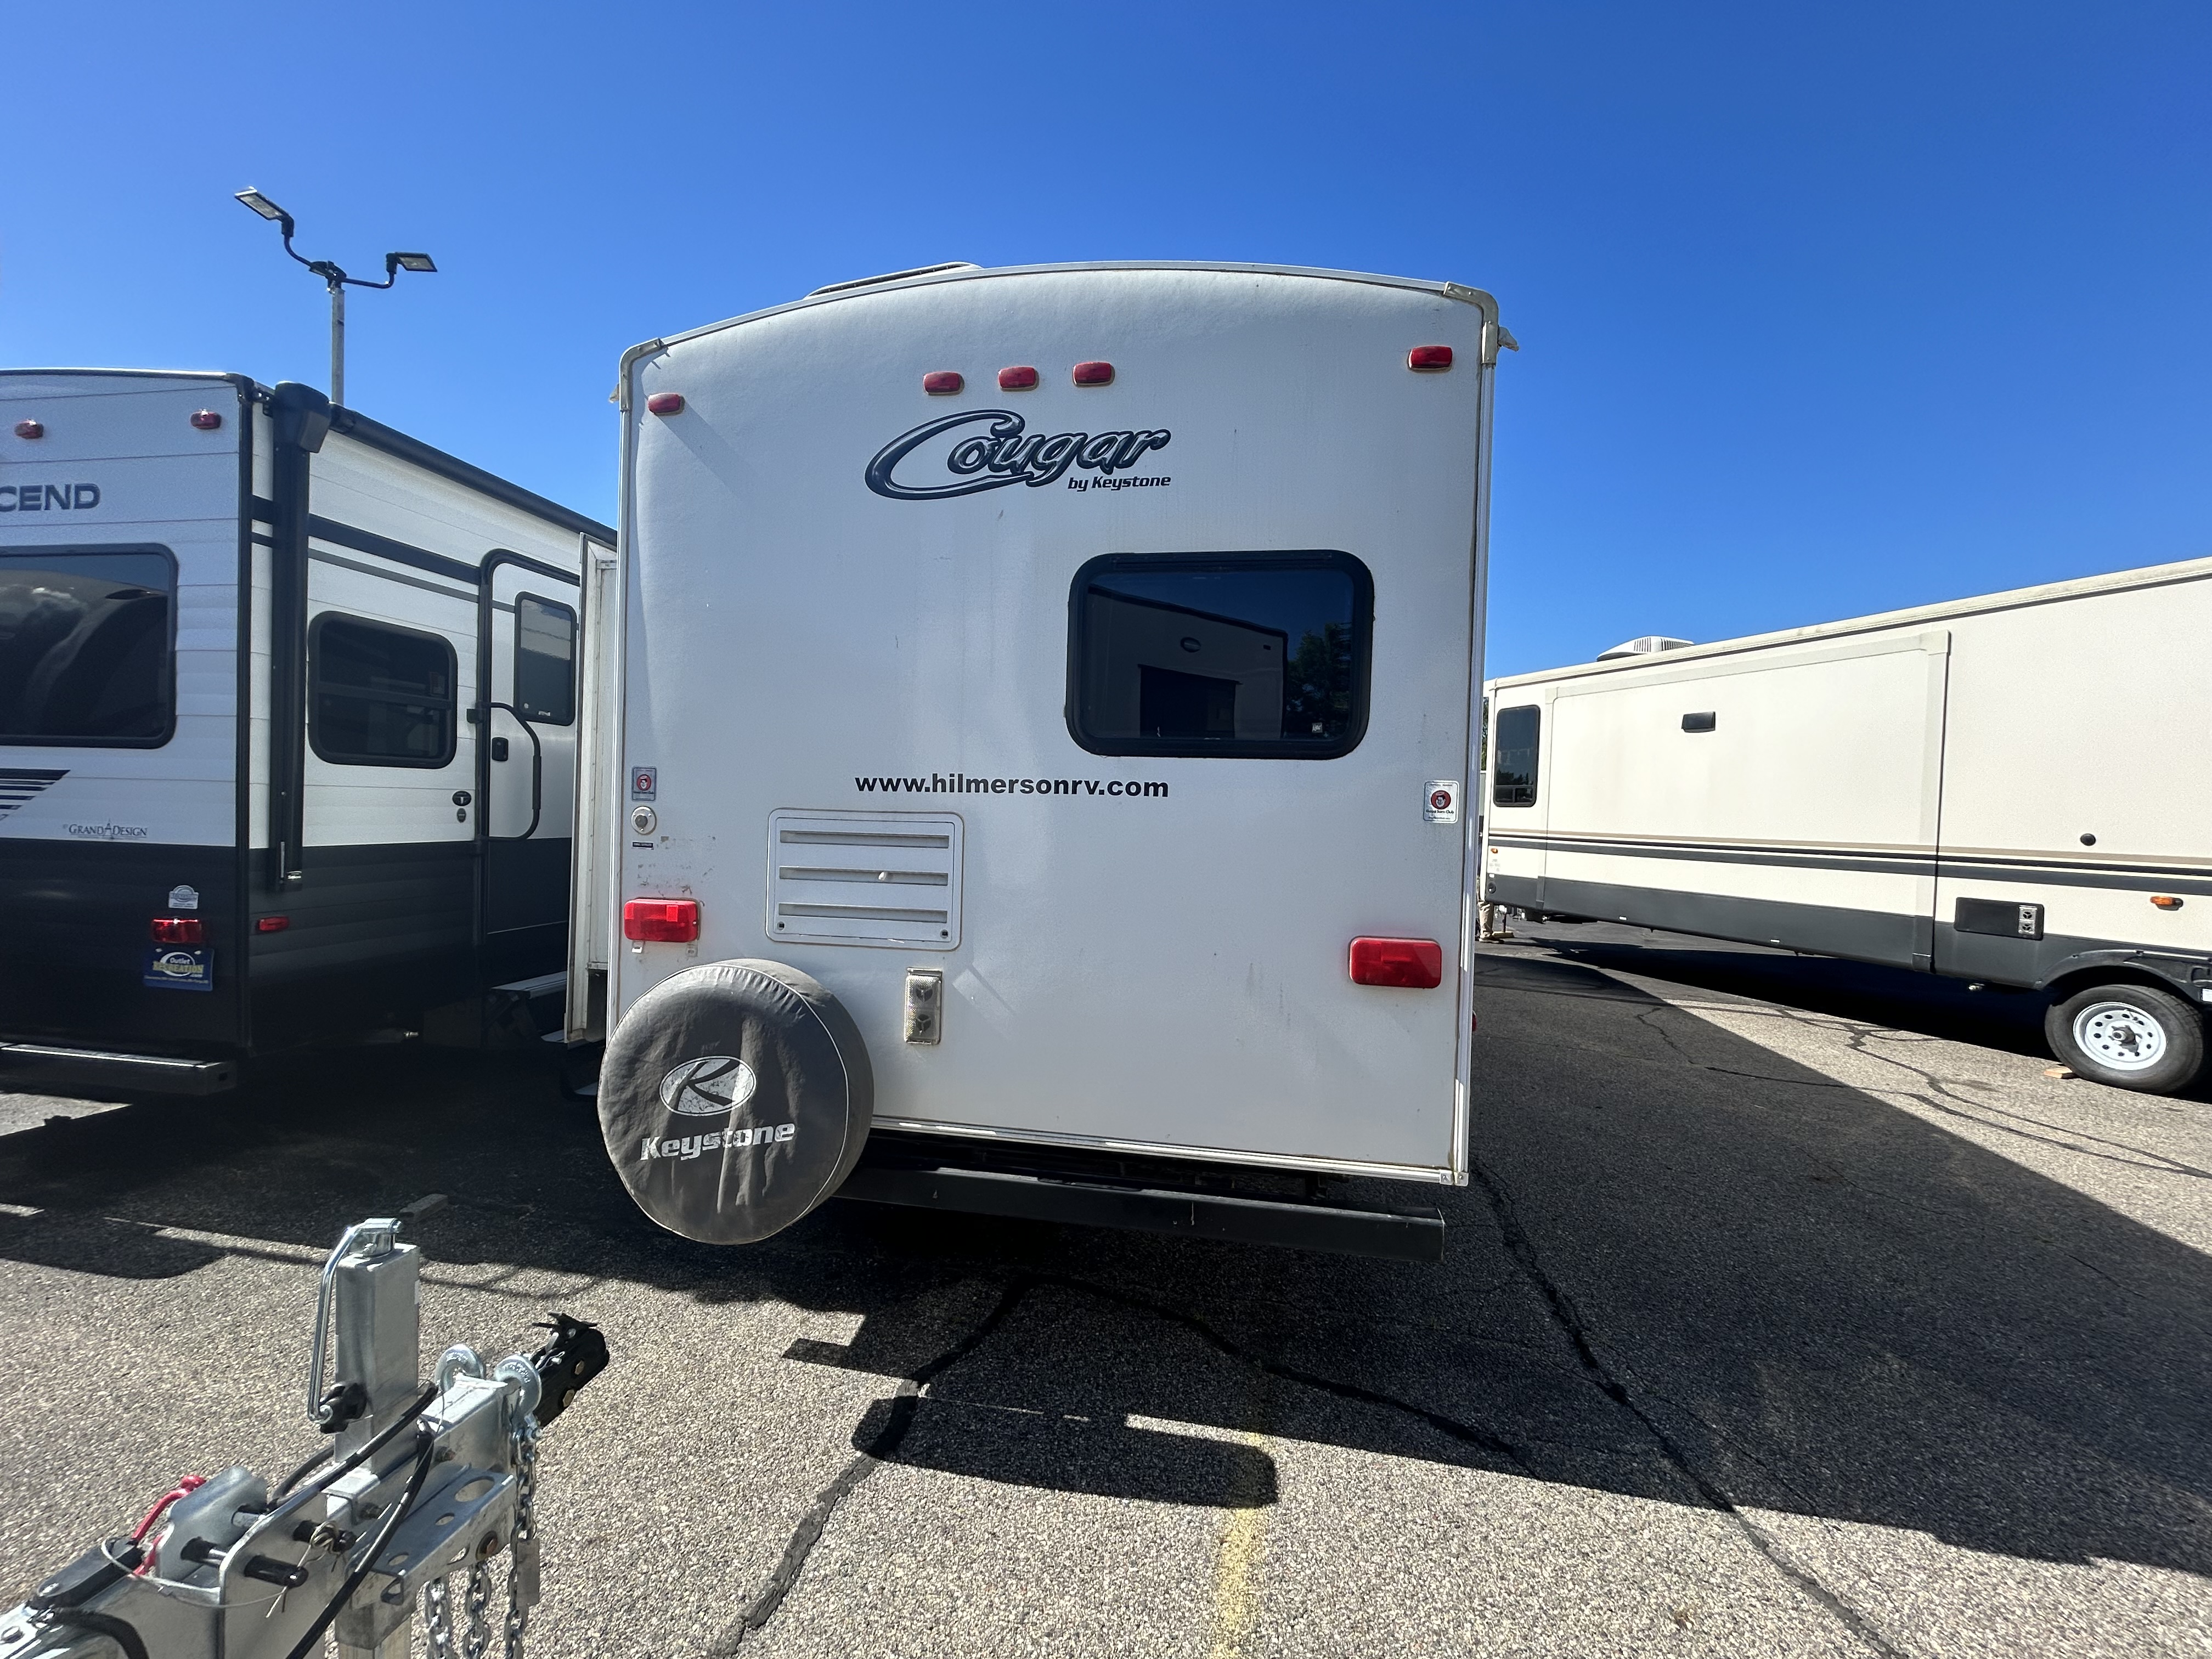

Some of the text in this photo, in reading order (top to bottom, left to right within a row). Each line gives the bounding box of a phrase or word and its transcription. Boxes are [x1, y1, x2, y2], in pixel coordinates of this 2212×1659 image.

[865, 409, 1171, 500] Cougar
[0, 483, 100, 512] CEND
[1068, 476, 1171, 492] by Keystone
[855, 772, 1169, 798] www.hilmersonrv.com
[69, 823, 148, 836] GRAND DESIGN
[640, 1123, 796, 1161] Keystone
